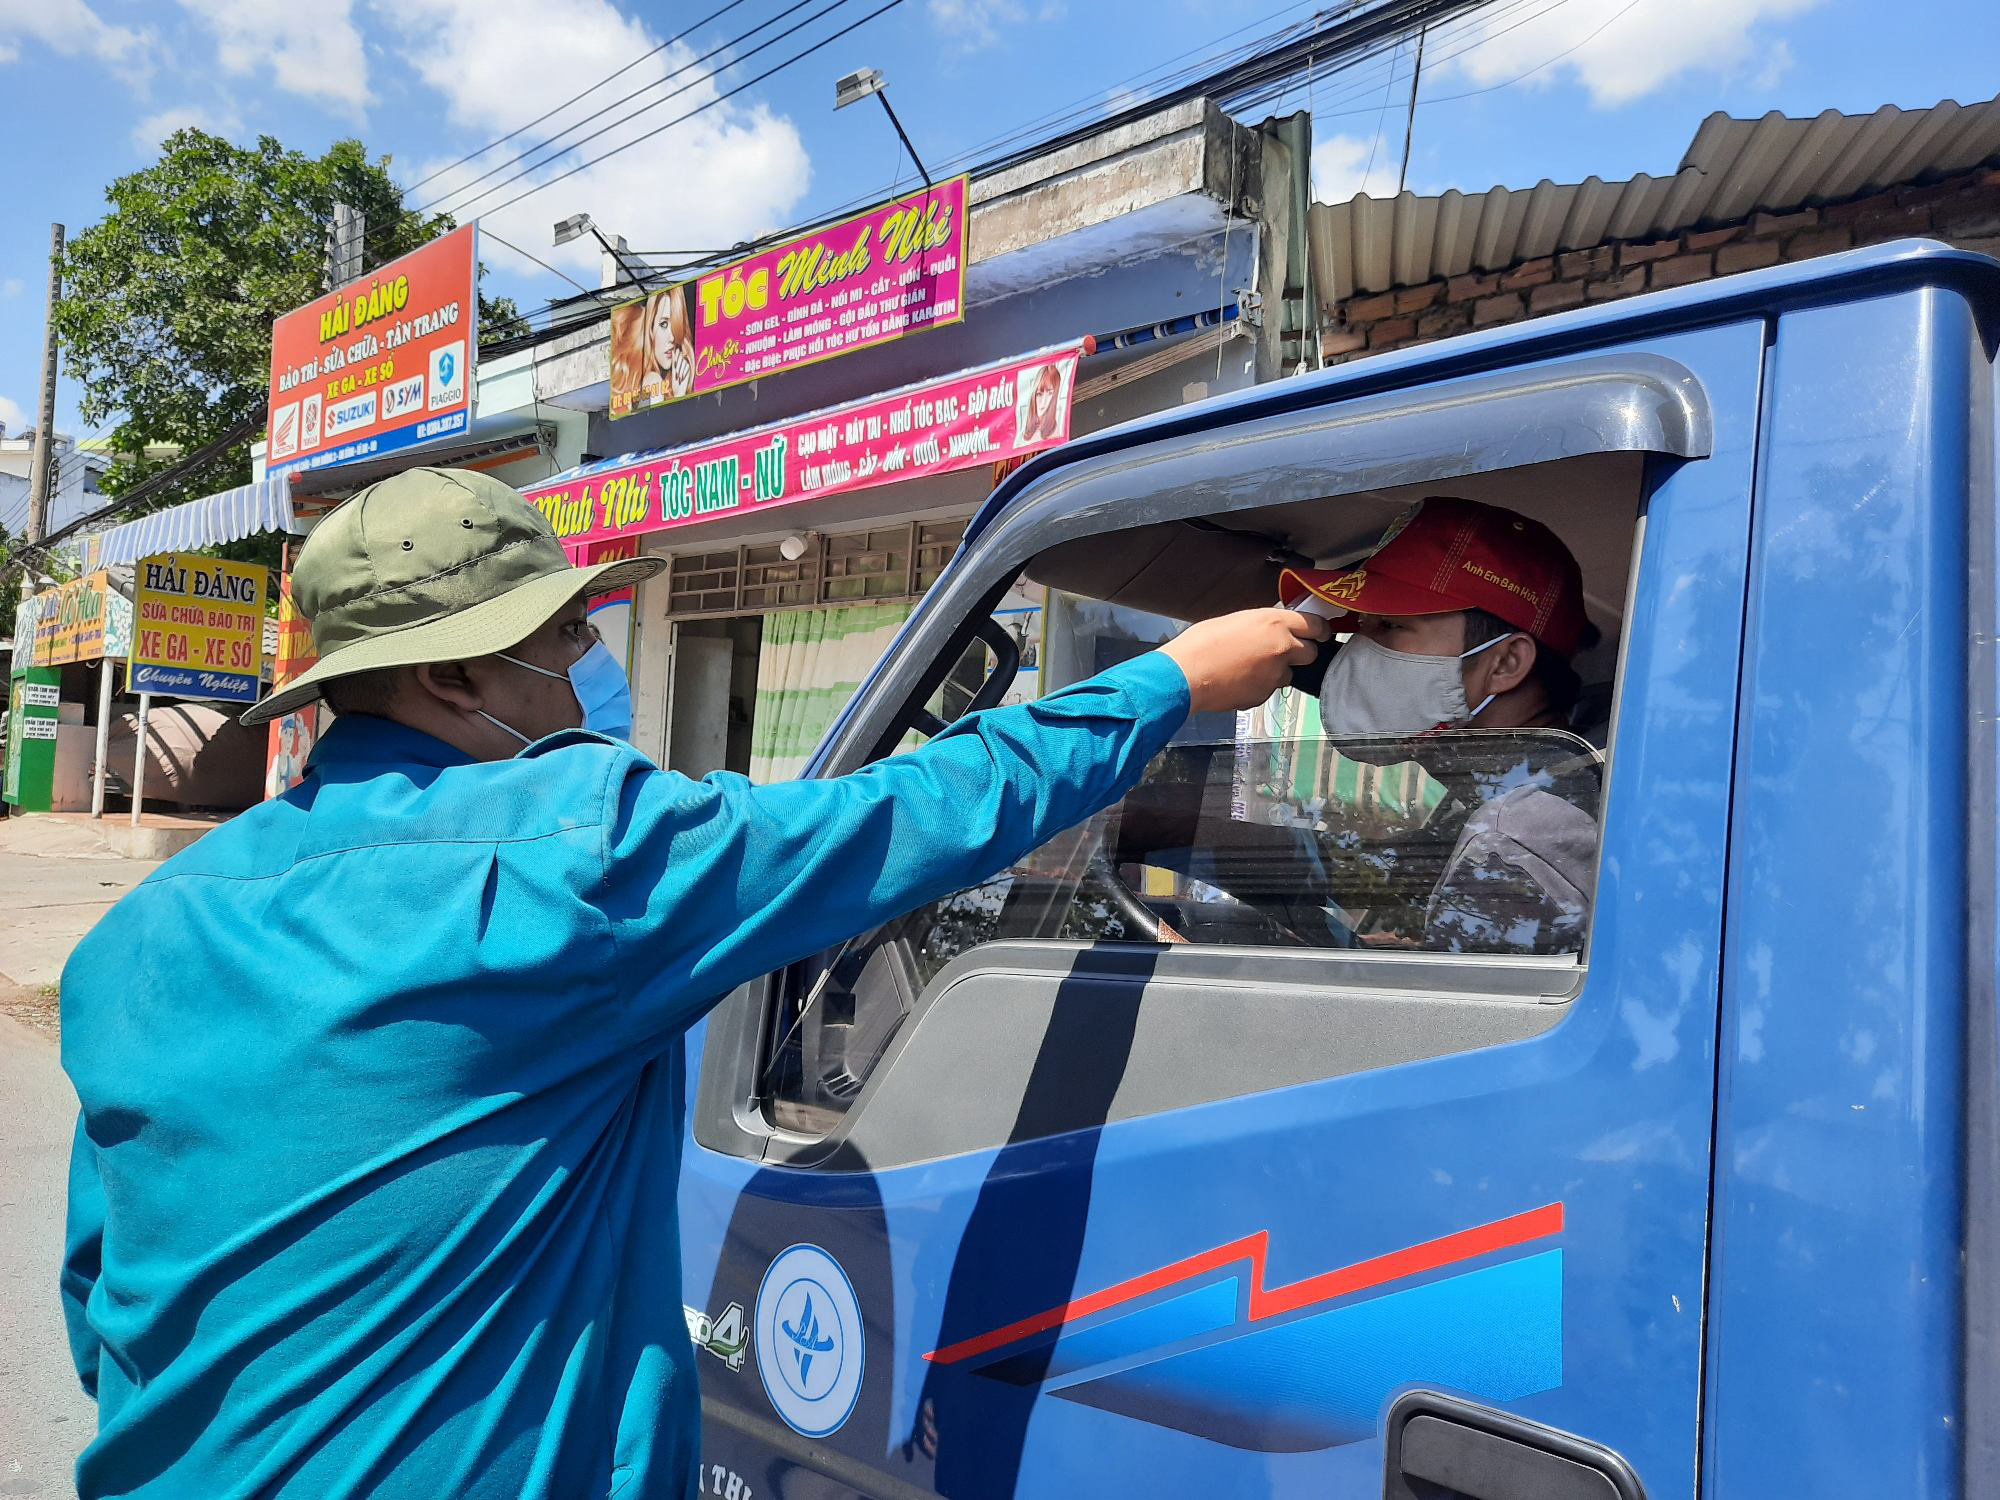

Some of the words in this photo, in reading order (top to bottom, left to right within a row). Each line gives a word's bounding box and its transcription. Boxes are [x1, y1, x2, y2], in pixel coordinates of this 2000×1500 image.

[699, 267, 768, 327] TÓC
[776, 225, 872, 300] Minh
[879, 200, 953, 264] Nhi
[319, 294, 350, 344] HẢI
[354, 275, 408, 327] ĐĂNG
[764, 315, 780, 331] GEL
[849, 287, 862, 303] MI
[912, 298, 956, 323] KARATIN
[279, 365, 299, 392] BẢO
[386, 321, 411, 349] TÂN
[414, 302, 459, 339] TRANG
[327, 380, 339, 401] XE
[341, 374, 356, 395] GA
[364, 366, 378, 387] XE
[397, 381, 422, 407] SYM
[431, 388, 461, 407] PIAGGIO
[337, 401, 374, 425] SUZUKI
[866, 415, 881, 440] TAI
[913, 400, 933, 430] TÓC
[935, 396, 959, 427] BẠC
[533, 485, 595, 538] Minh
[600, 471, 653, 530] Nhi
[659, 460, 693, 522] TÓC
[695, 454, 740, 515] NAM
[755, 433, 787, 502] NỮ
[800, 464, 821, 491] LÀM
[821, 459, 851, 487] MÓNG
[145, 556, 187, 595] HẢI
[193, 566, 256, 605] ĐĂNG
[1462, 560, 1484, 577] Anh
[1483, 570, 1500, 585] Em
[139, 629, 162, 659] XE
[166, 633, 188, 661] GA
[204, 637, 226, 666] XE
[231, 634, 255, 669] SỐ
[137, 667, 193, 687] Chuyên
[197, 672, 249, 693] Nghiệp
